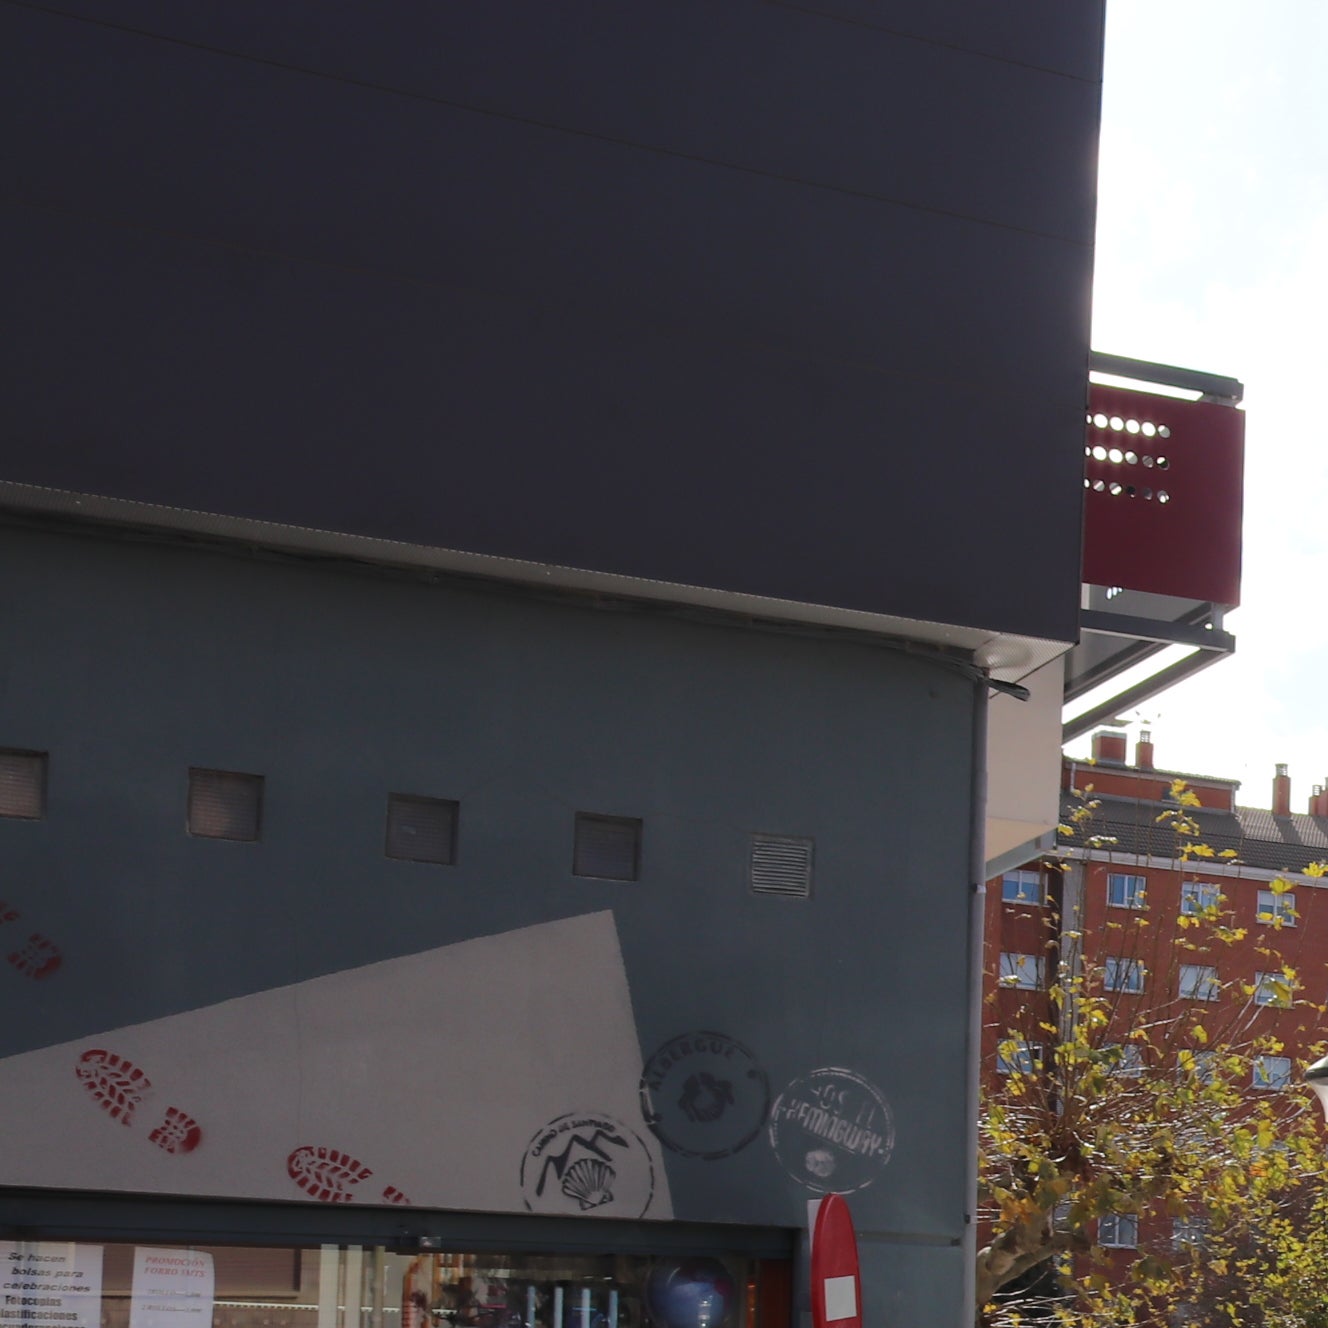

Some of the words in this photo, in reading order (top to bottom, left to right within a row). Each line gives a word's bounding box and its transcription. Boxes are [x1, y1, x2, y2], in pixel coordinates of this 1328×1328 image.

[8, 1252, 24, 1261] Se
[27, 1254, 66, 1262] hacen
[11, 1267, 51, 1276] bolsas
[54, 1270, 84, 1278] para
[3, 1282, 91, 1292] celebraciones
[0, 1309, 78, 1320] lastificaciones
